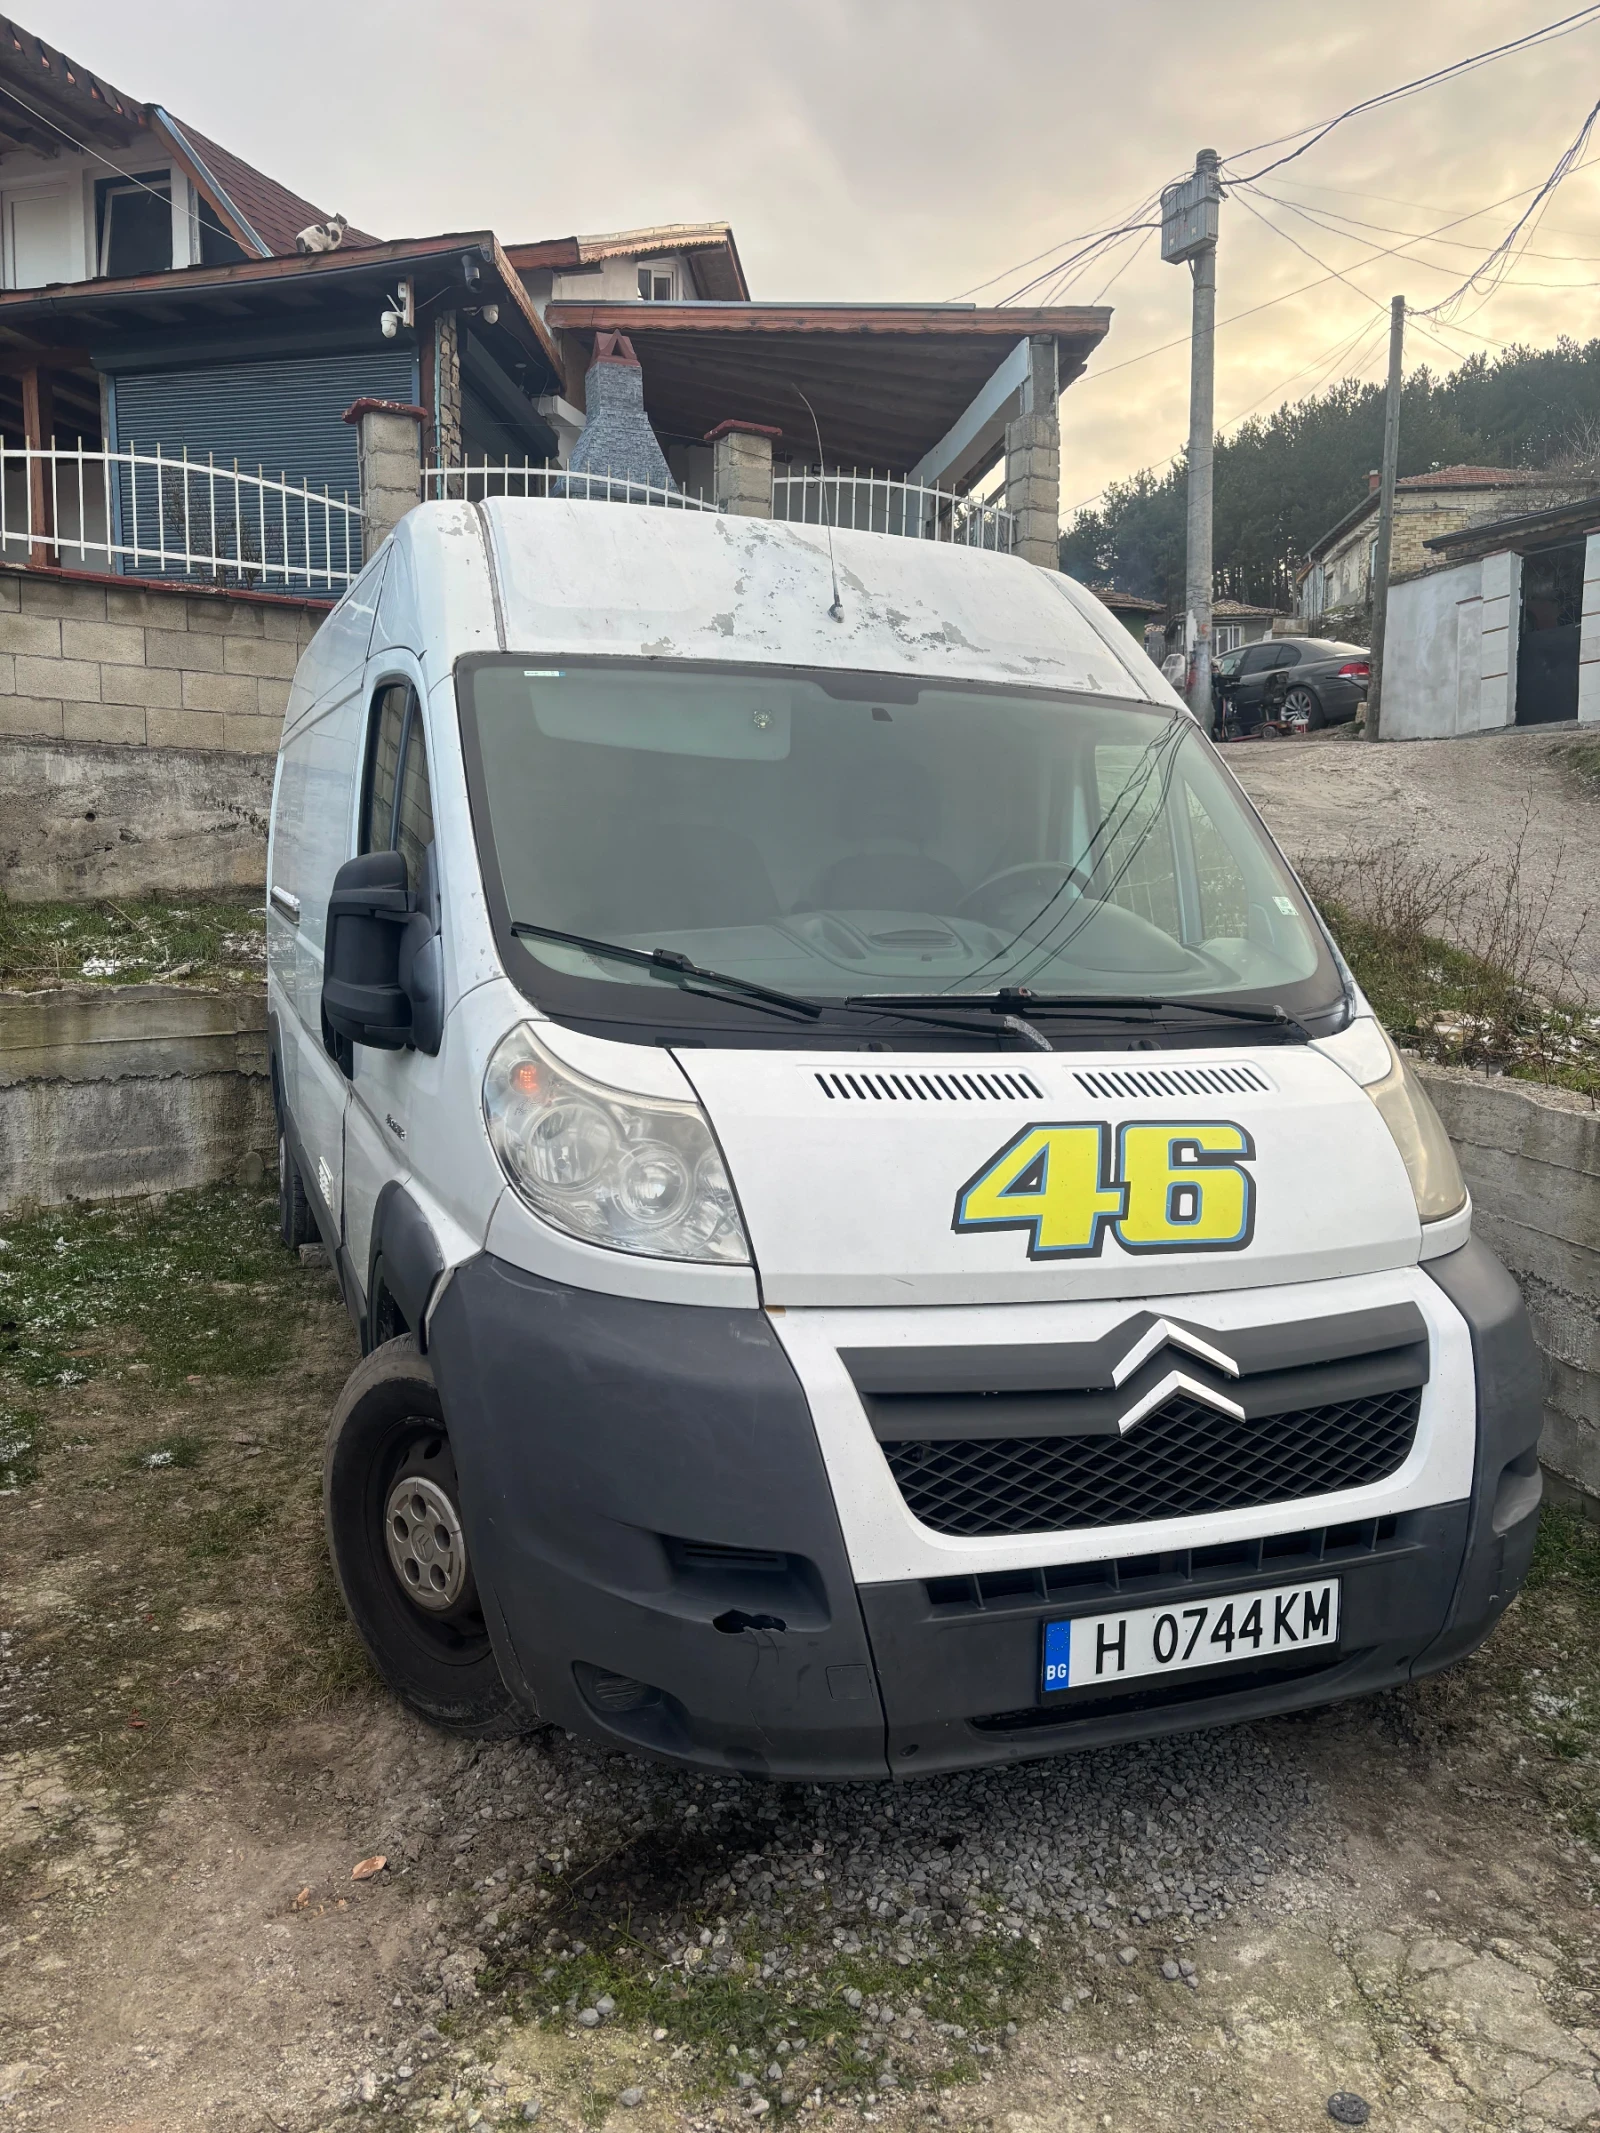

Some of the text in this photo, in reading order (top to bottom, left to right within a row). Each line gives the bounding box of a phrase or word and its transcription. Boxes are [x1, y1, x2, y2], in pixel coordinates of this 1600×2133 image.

[951, 1120, 1256, 1261] 46
[1046, 1663, 1067, 1681] BG
[1096, 1619, 1126, 1675] H
